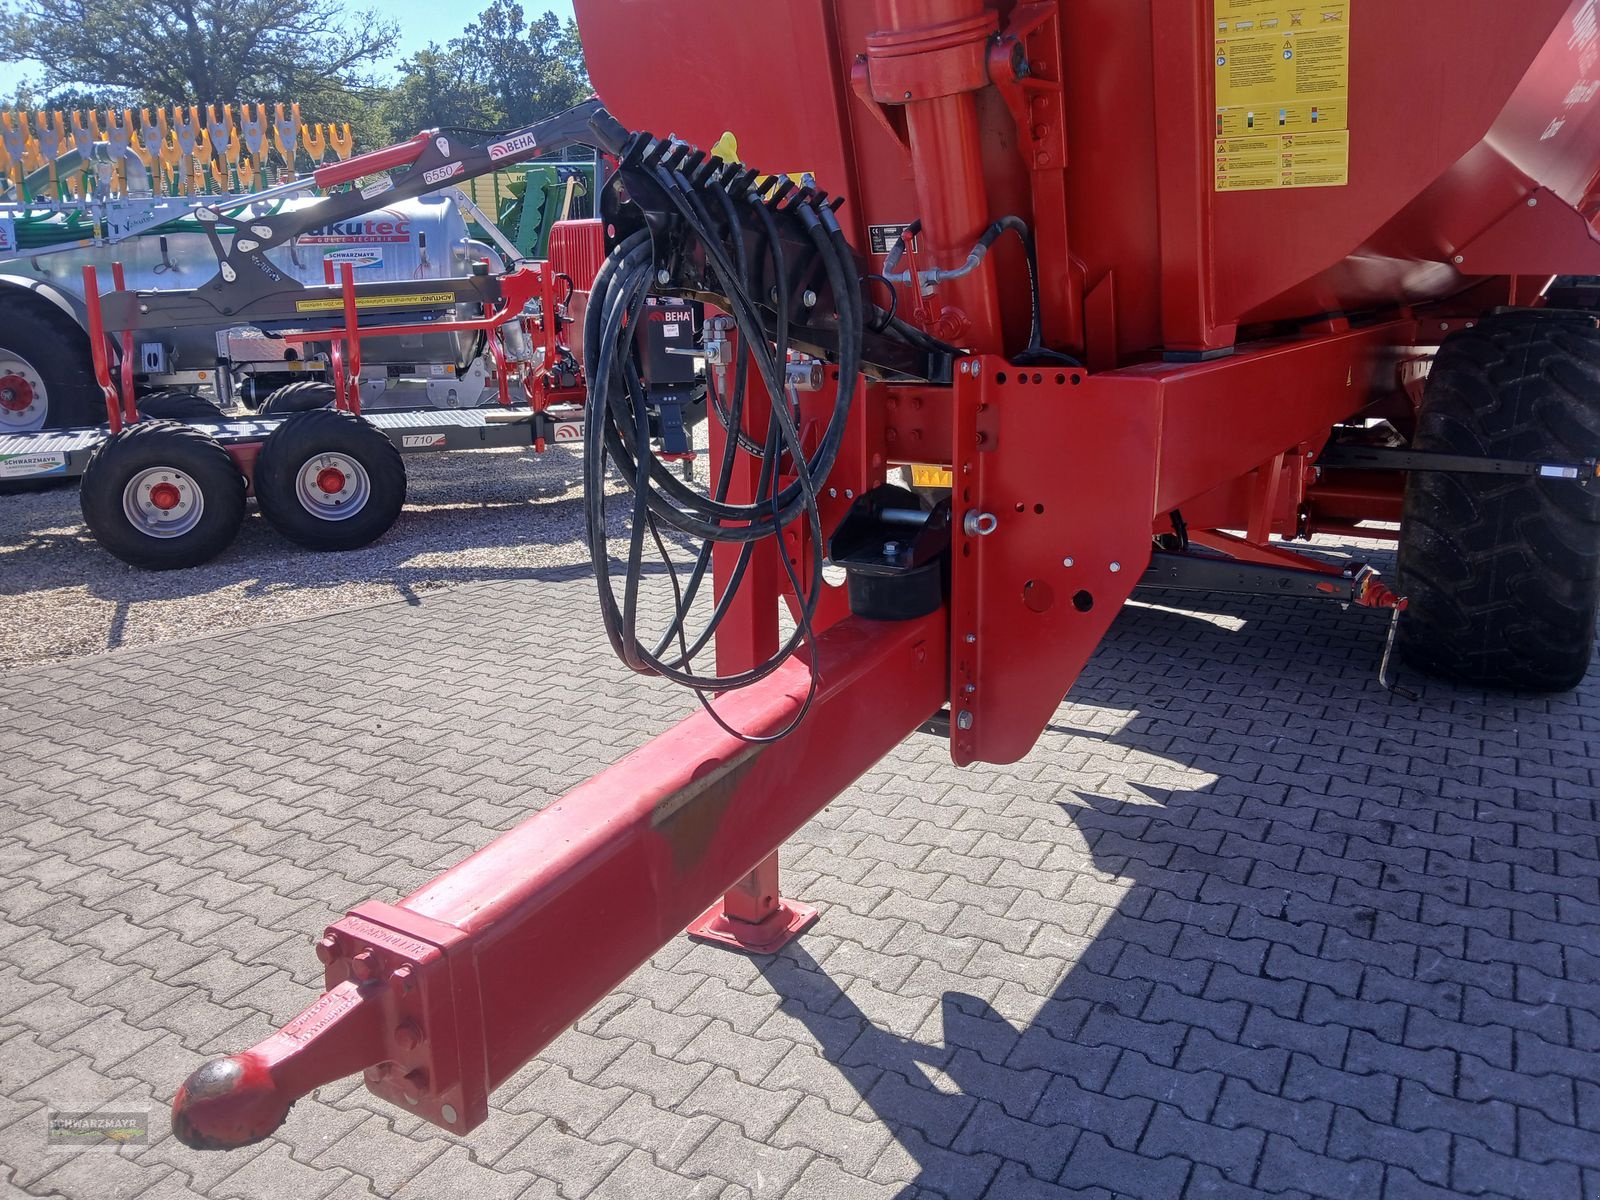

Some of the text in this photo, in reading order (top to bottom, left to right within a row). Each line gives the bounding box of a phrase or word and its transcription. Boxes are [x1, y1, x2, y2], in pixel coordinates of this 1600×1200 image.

[506, 135, 536, 152] BEHA
[425, 165, 453, 182] 6550
[308, 220, 411, 236] akutec
[665, 311, 690, 321] BEHA
[404, 435, 433, 445] T 710
[4, 457, 56, 465] SCHWARZMAYR
